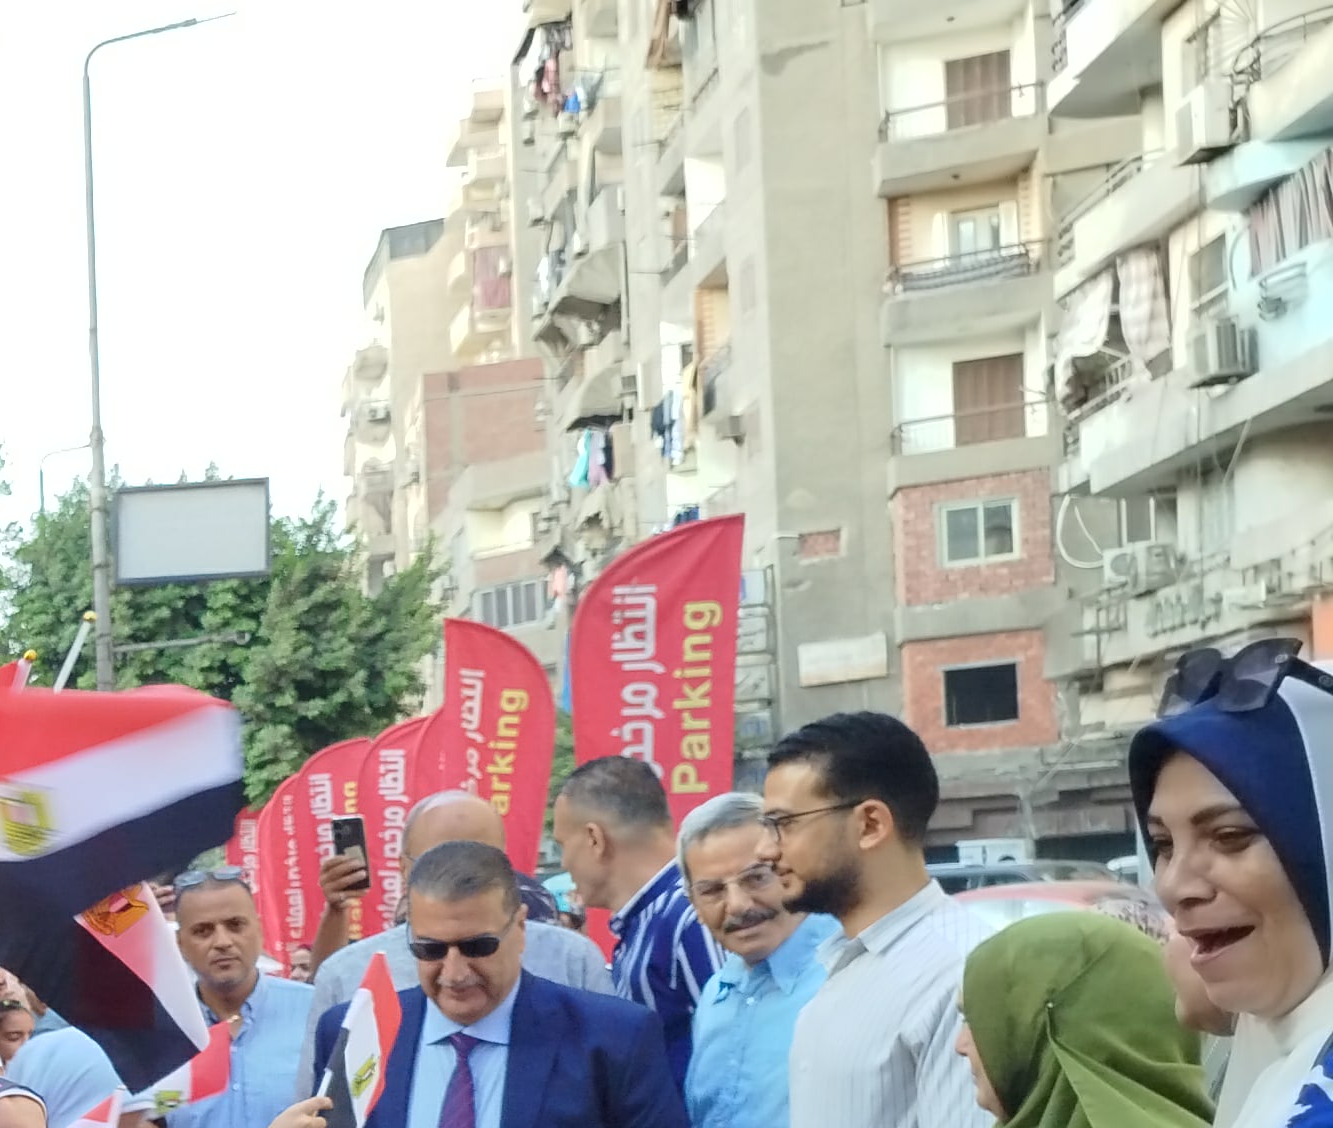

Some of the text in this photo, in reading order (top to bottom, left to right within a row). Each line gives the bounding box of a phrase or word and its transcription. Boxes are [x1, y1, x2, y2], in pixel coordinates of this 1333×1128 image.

[611, 584, 666, 674] انتظار
[486, 688, 530, 816] arking
[671, 600, 723, 793] Parking
